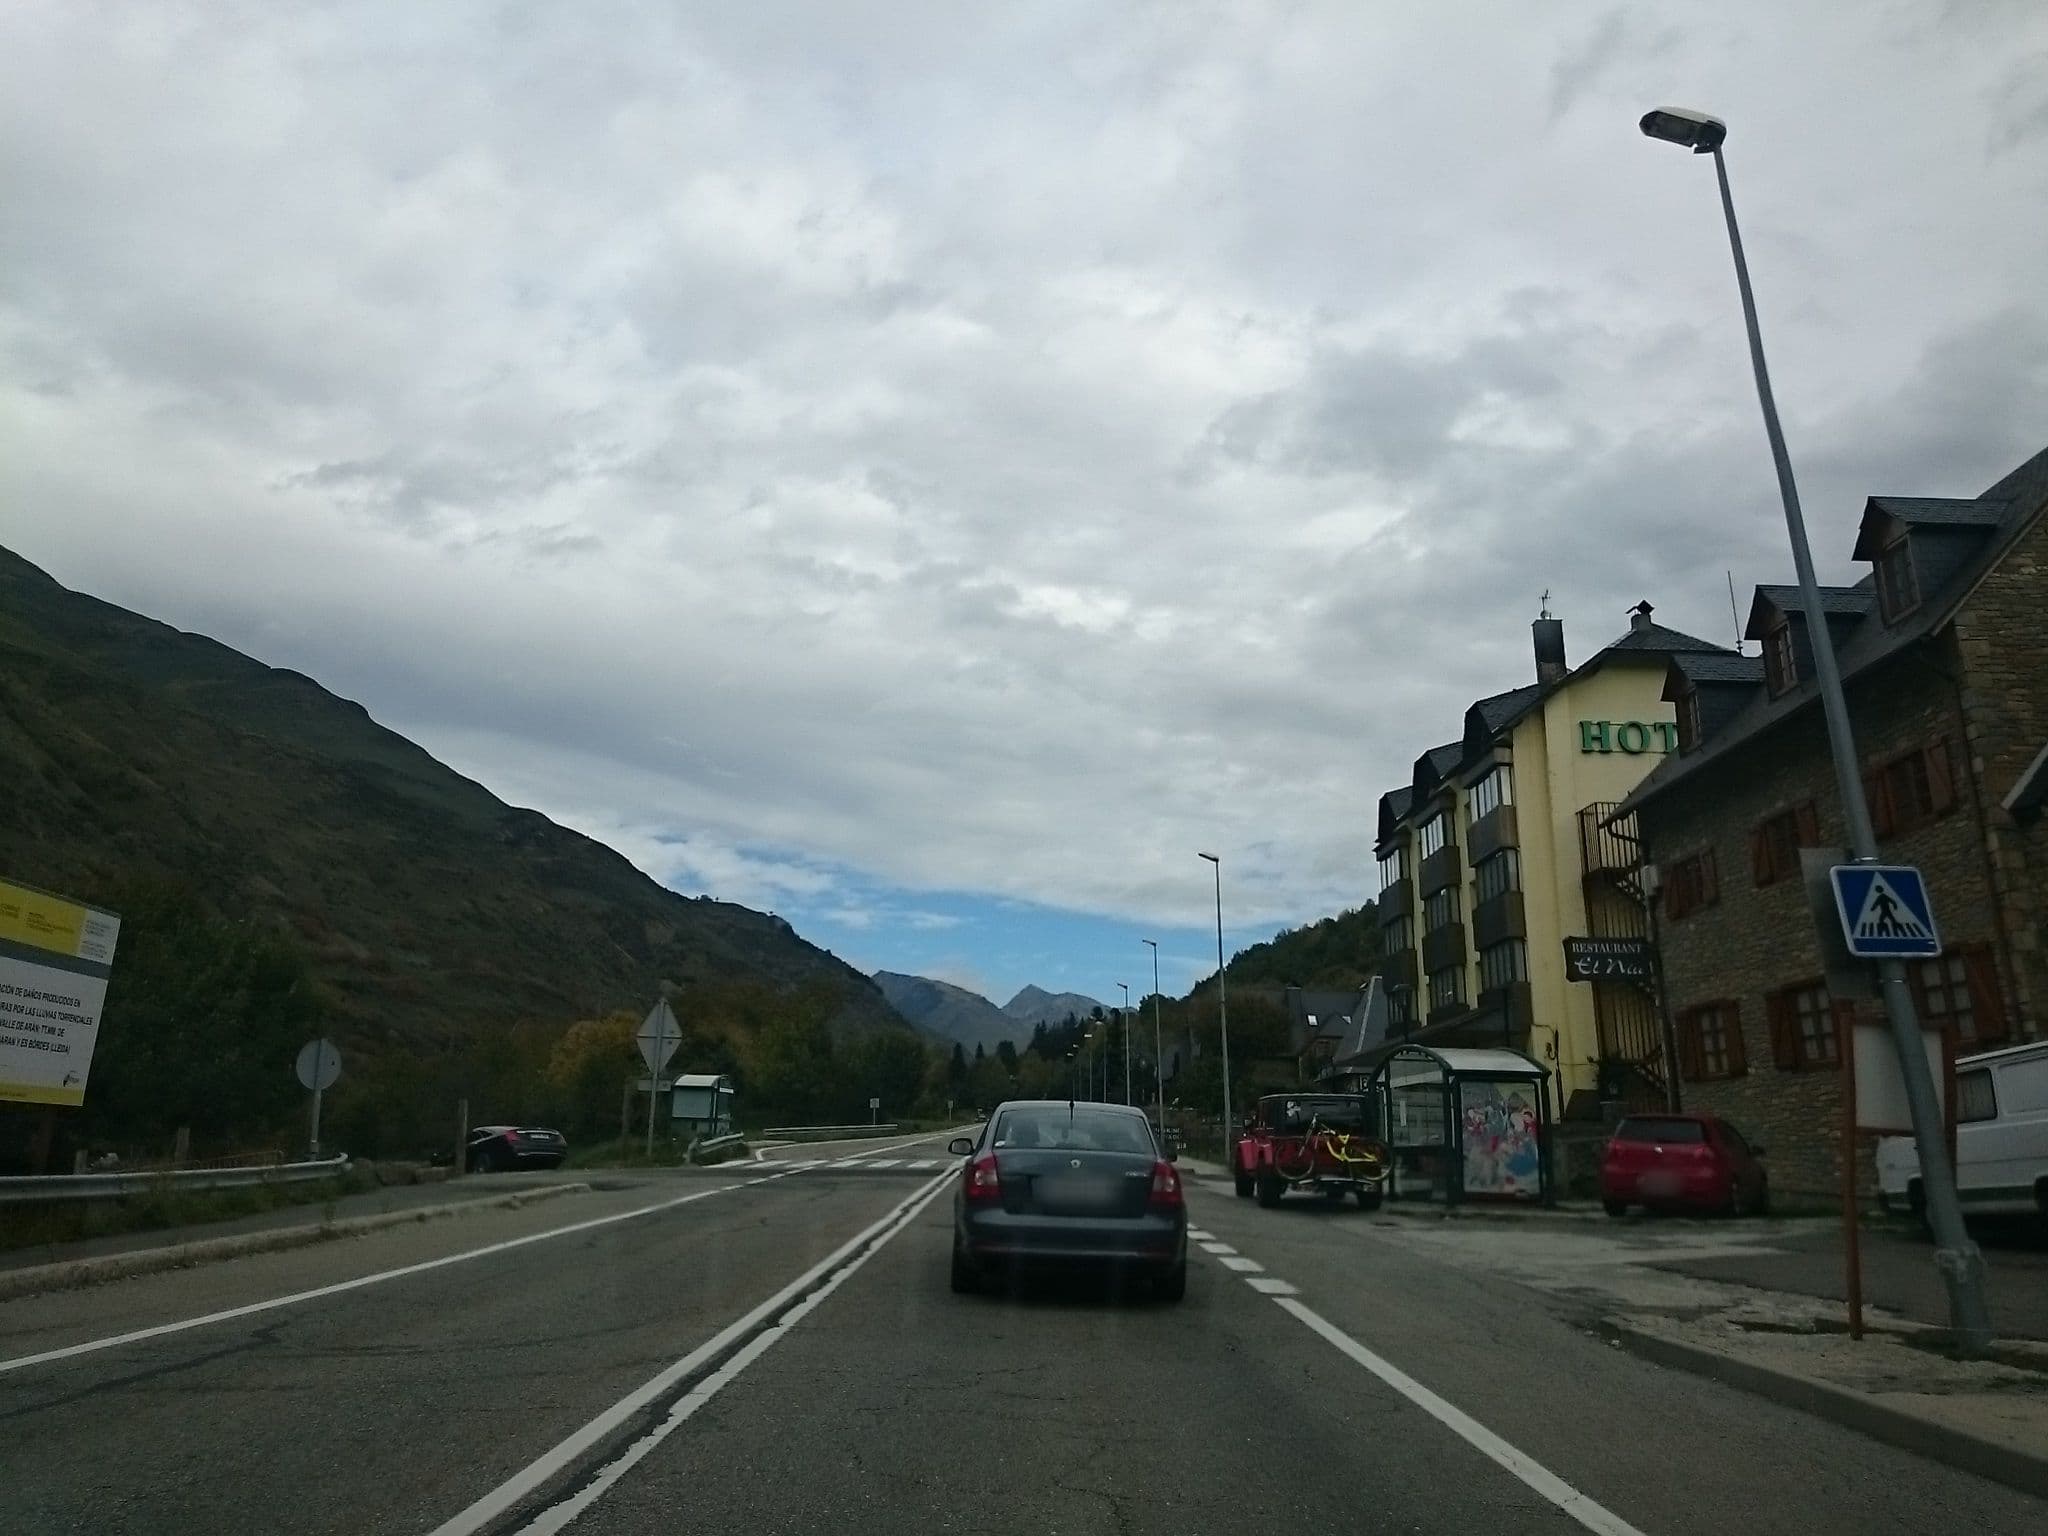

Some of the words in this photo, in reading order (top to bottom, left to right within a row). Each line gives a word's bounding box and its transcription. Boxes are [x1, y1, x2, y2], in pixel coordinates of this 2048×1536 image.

[1572, 942, 1642, 953] RESTAURANT
[15, 987, 23, 997] DE
[23, 988, 42, 1000] DAÑOS
[42, 992, 73, 1006] PRODUCIDOS
[74, 998, 81, 1008] EN
[13, 1003, 24, 1014] POR
[25, 1006, 35, 1016] LAS
[36, 1009, 57, 1020] LLUVIAS
[58, 1012, 93, 1025] TORRENCIALES
[16, 1021, 23, 1031] DE
[57, 1027, 65, 1037] DE
[16, 1037, 21, 1046] Y
[21, 1038, 28, 1048] ES
